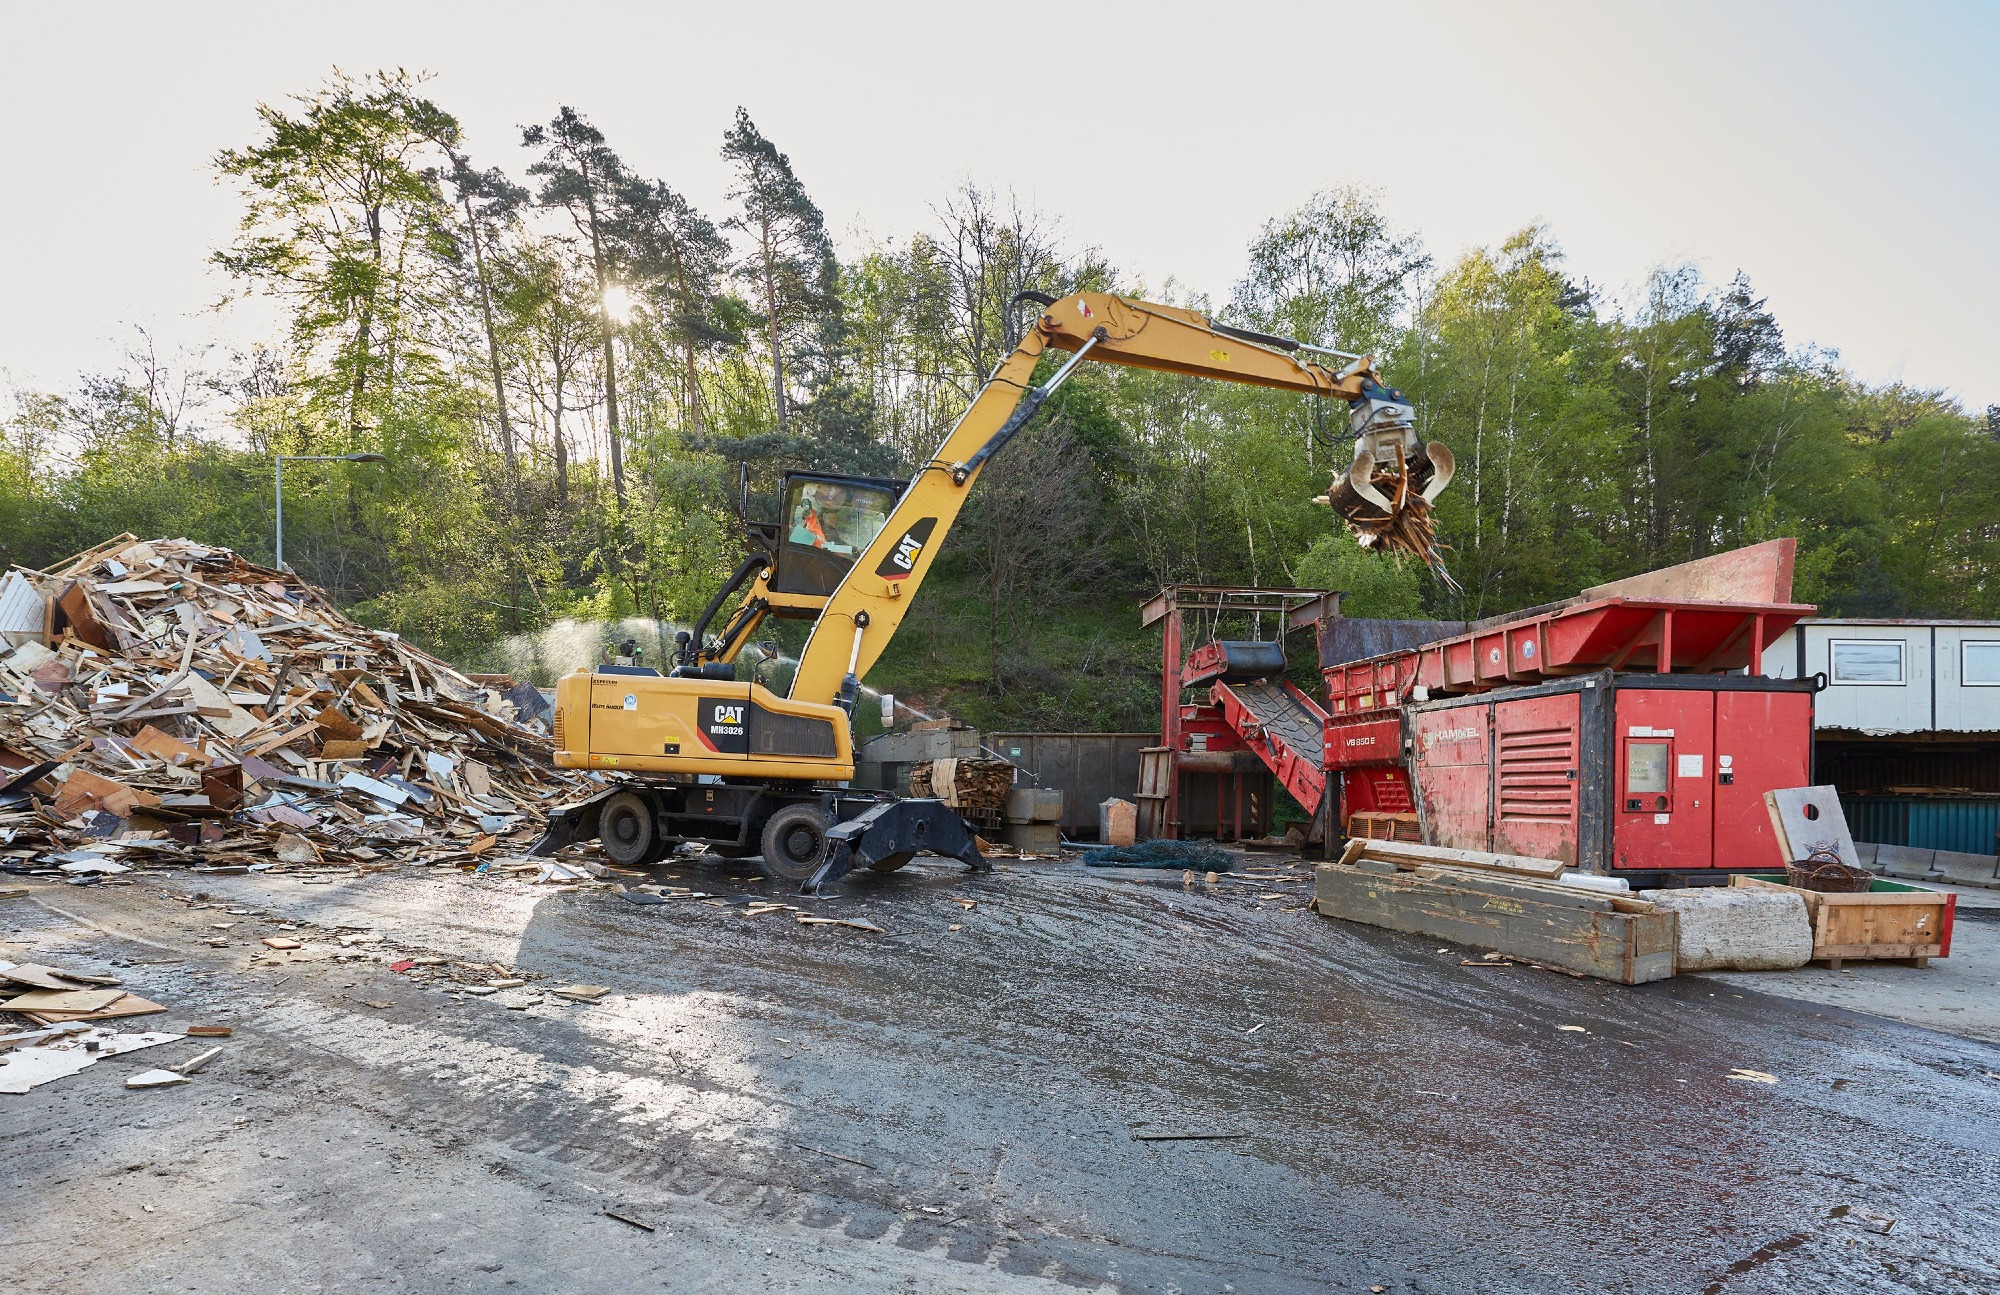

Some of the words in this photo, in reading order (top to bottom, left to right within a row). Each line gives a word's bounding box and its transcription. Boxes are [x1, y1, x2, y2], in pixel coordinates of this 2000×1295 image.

[893, 533, 922, 570] CAT
[714, 705, 744, 724] CAT
[710, 725, 743, 735] MH3026
[1434, 727, 1479, 740] HAMMEL
